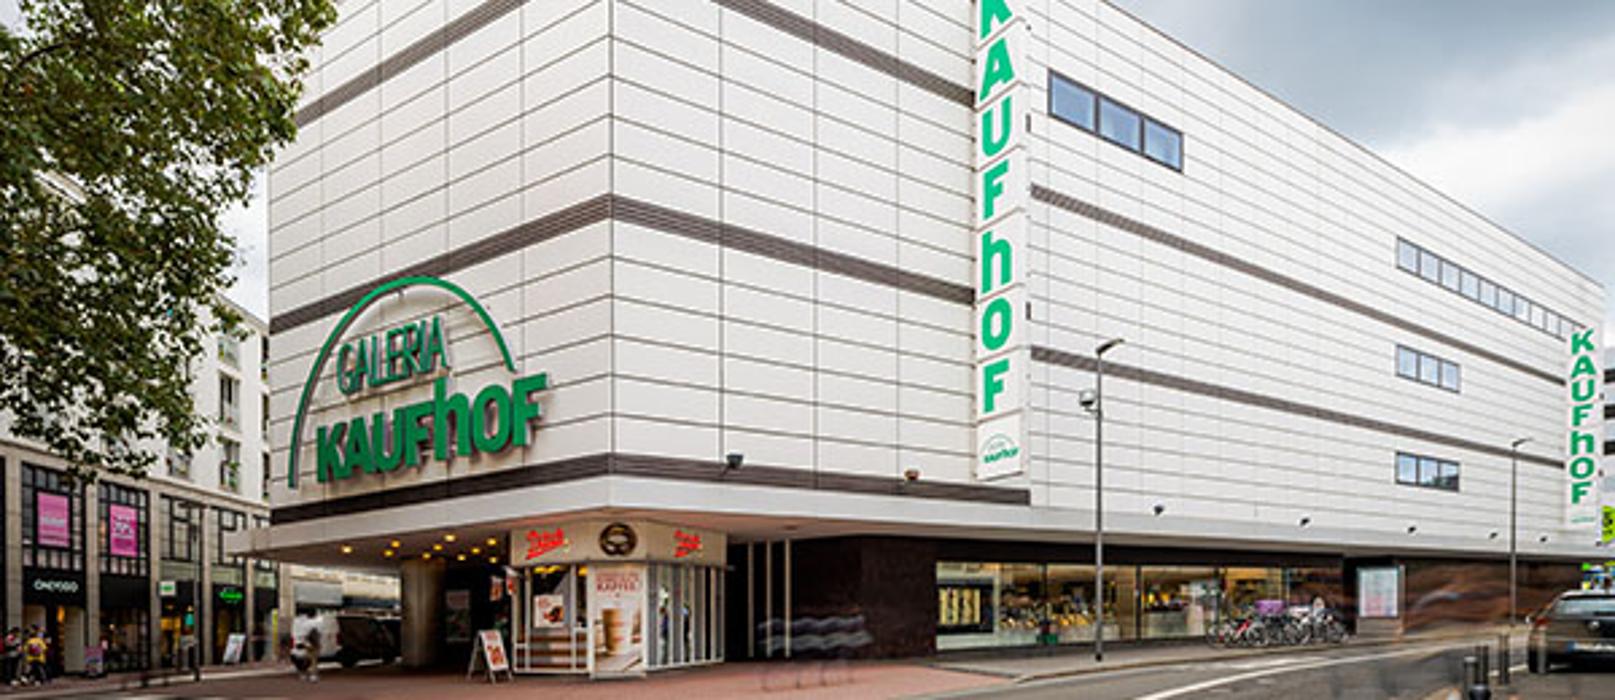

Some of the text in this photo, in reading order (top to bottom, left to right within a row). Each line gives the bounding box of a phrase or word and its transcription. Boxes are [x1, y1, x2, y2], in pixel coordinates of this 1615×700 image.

[337, 315, 448, 396] GALERIA
[317, 373, 547, 482] KAUFhOF
[1570, 328, 1597, 505] KAUFhOF
